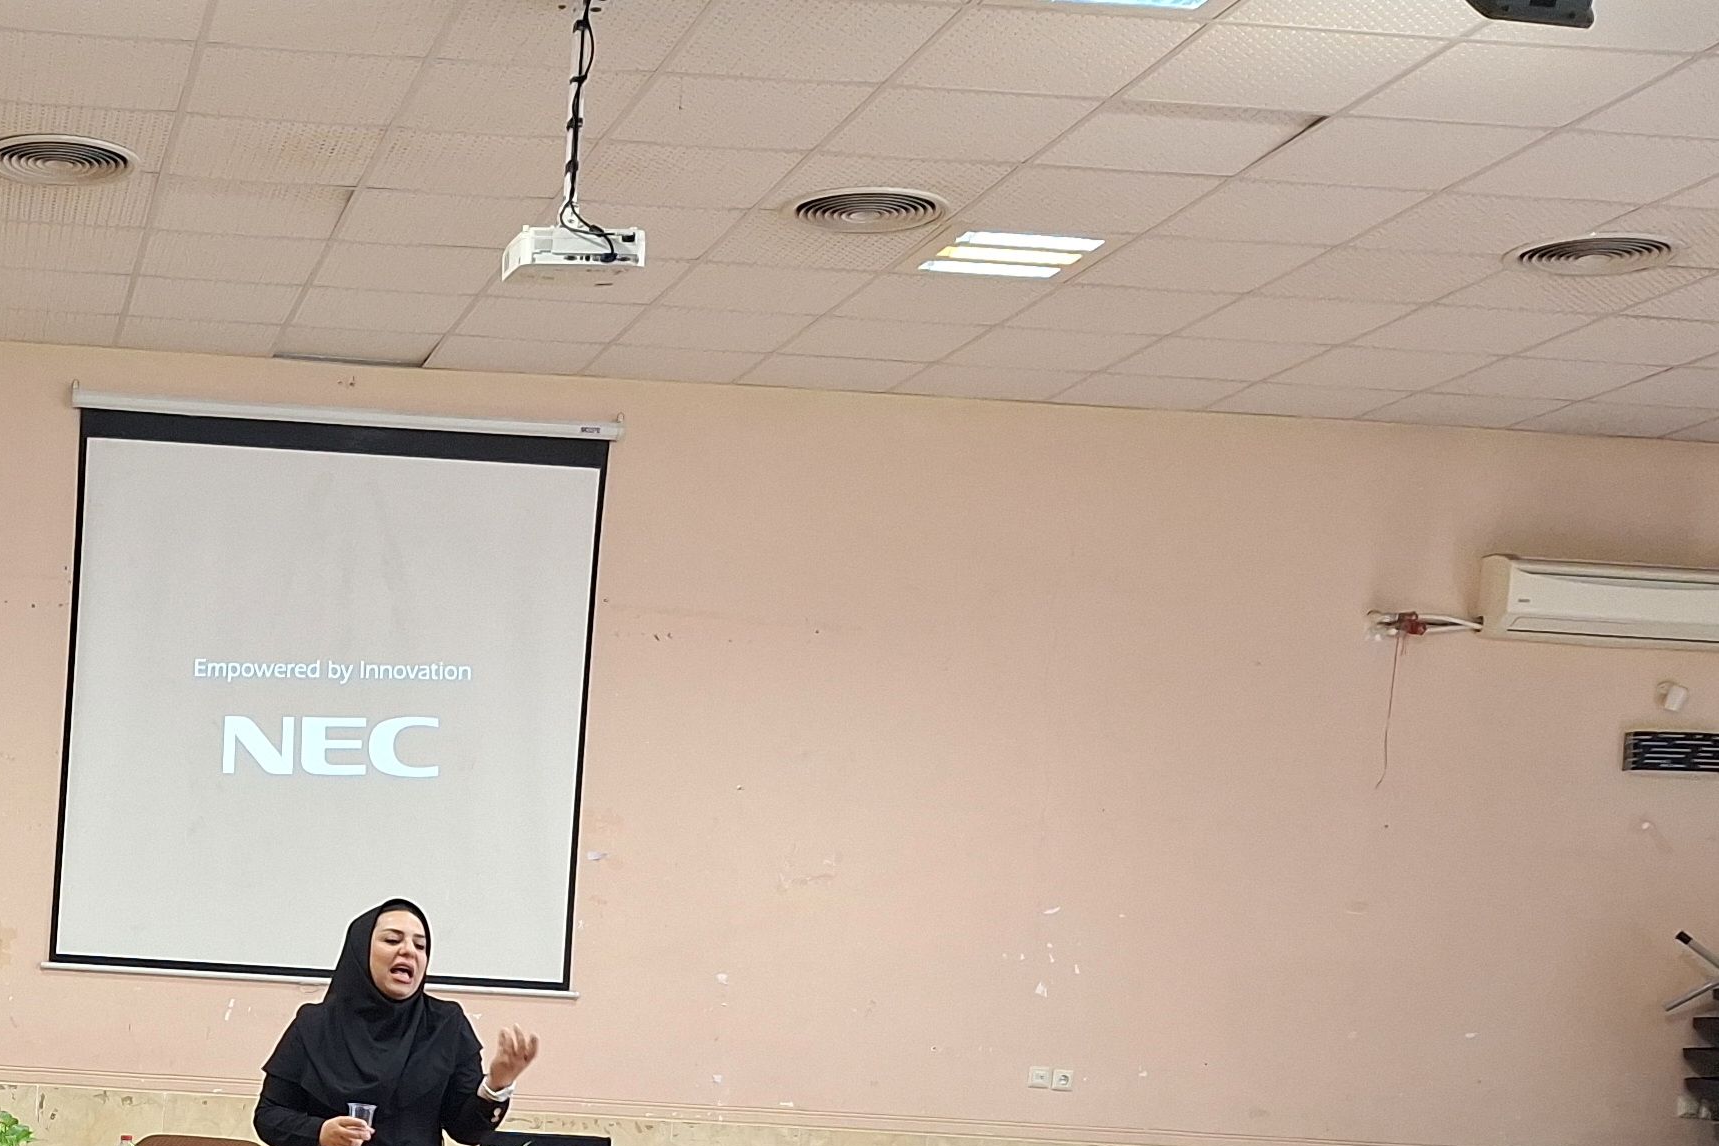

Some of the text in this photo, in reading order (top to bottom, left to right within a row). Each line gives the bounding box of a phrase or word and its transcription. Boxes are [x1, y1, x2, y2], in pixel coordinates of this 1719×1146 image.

[193, 658, 472, 684] Empowered by Innovation
[222, 715, 439, 777] NEC
